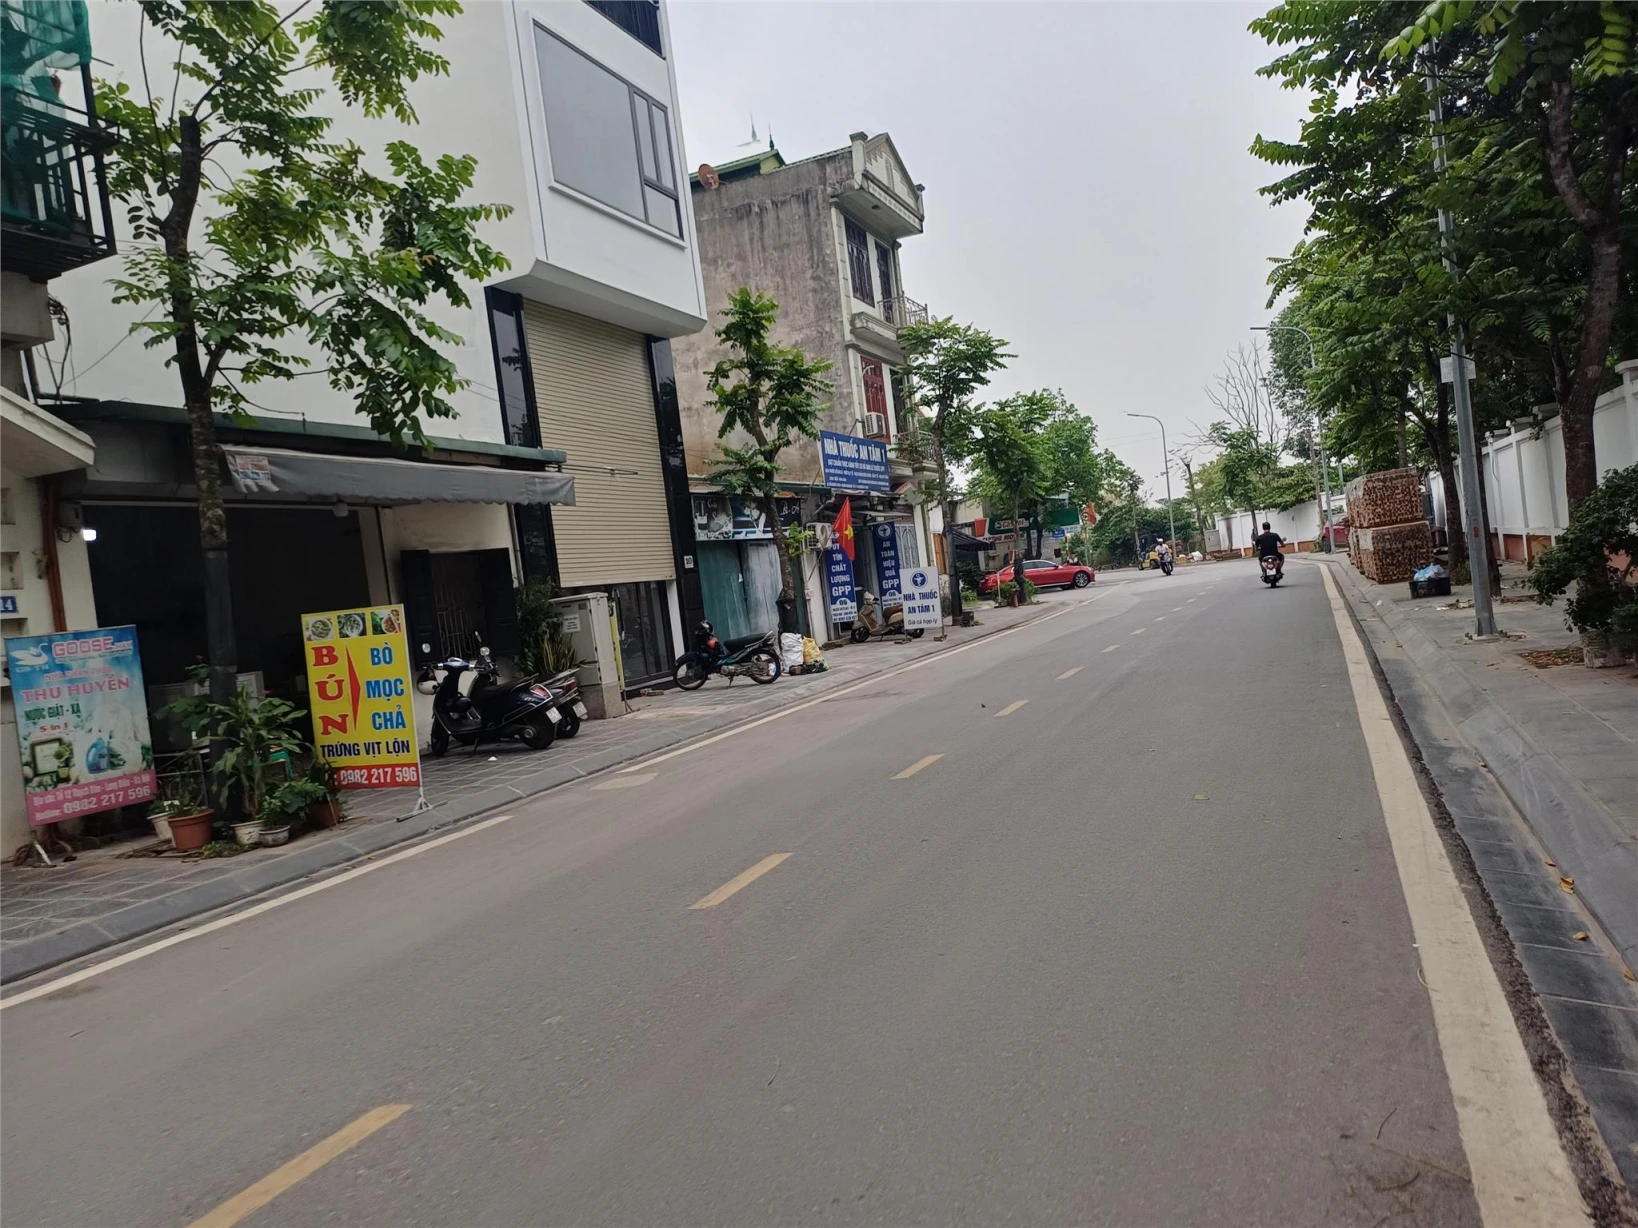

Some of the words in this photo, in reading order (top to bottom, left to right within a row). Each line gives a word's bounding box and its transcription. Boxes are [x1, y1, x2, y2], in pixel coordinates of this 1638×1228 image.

[824, 436, 838, 455] NHÀ
[838, 438, 858, 459] THUỐC
[859, 445, 868, 460] AN
[868, 444, 881, 462] TÂM
[881, 449, 885, 463] 1
[832, 552, 843, 561] TÍN
[881, 549, 894, 558] TOÀN
[831, 562, 846, 572] CHẤT
[883, 560, 895, 568] HIỆU
[830, 574, 850, 584] LƯỢNG
[882, 579, 899, 589] GPP
[832, 586, 851, 596] GPP
[903, 592, 915, 601] NHÀ
[919, 589, 938, 600] THUỐC
[908, 606, 916, 614] AN
[917, 604, 930, 613] TÂM
[53, 638, 113, 657] GOOSE
[370, 642, 393, 666] BÒ
[22, 686, 61, 703] THU
[67, 674, 129, 697] HUYỀN
[311, 645, 349, 736] BÚN
[366, 678, 404, 701] MỌC
[372, 705, 406, 731] CHẢ
[320, 740, 360, 758] TRỨNG
[364, 740, 381, 758] VỊT
[386, 738, 410, 757] LỘN
[340, 768, 368, 785] 0982
[371, 767, 392, 784] 217
[395, 766, 417, 783] 596
[63, 797, 97, 814] 0982
[100, 791, 124, 806] 217
[127, 785, 150, 800] 596
